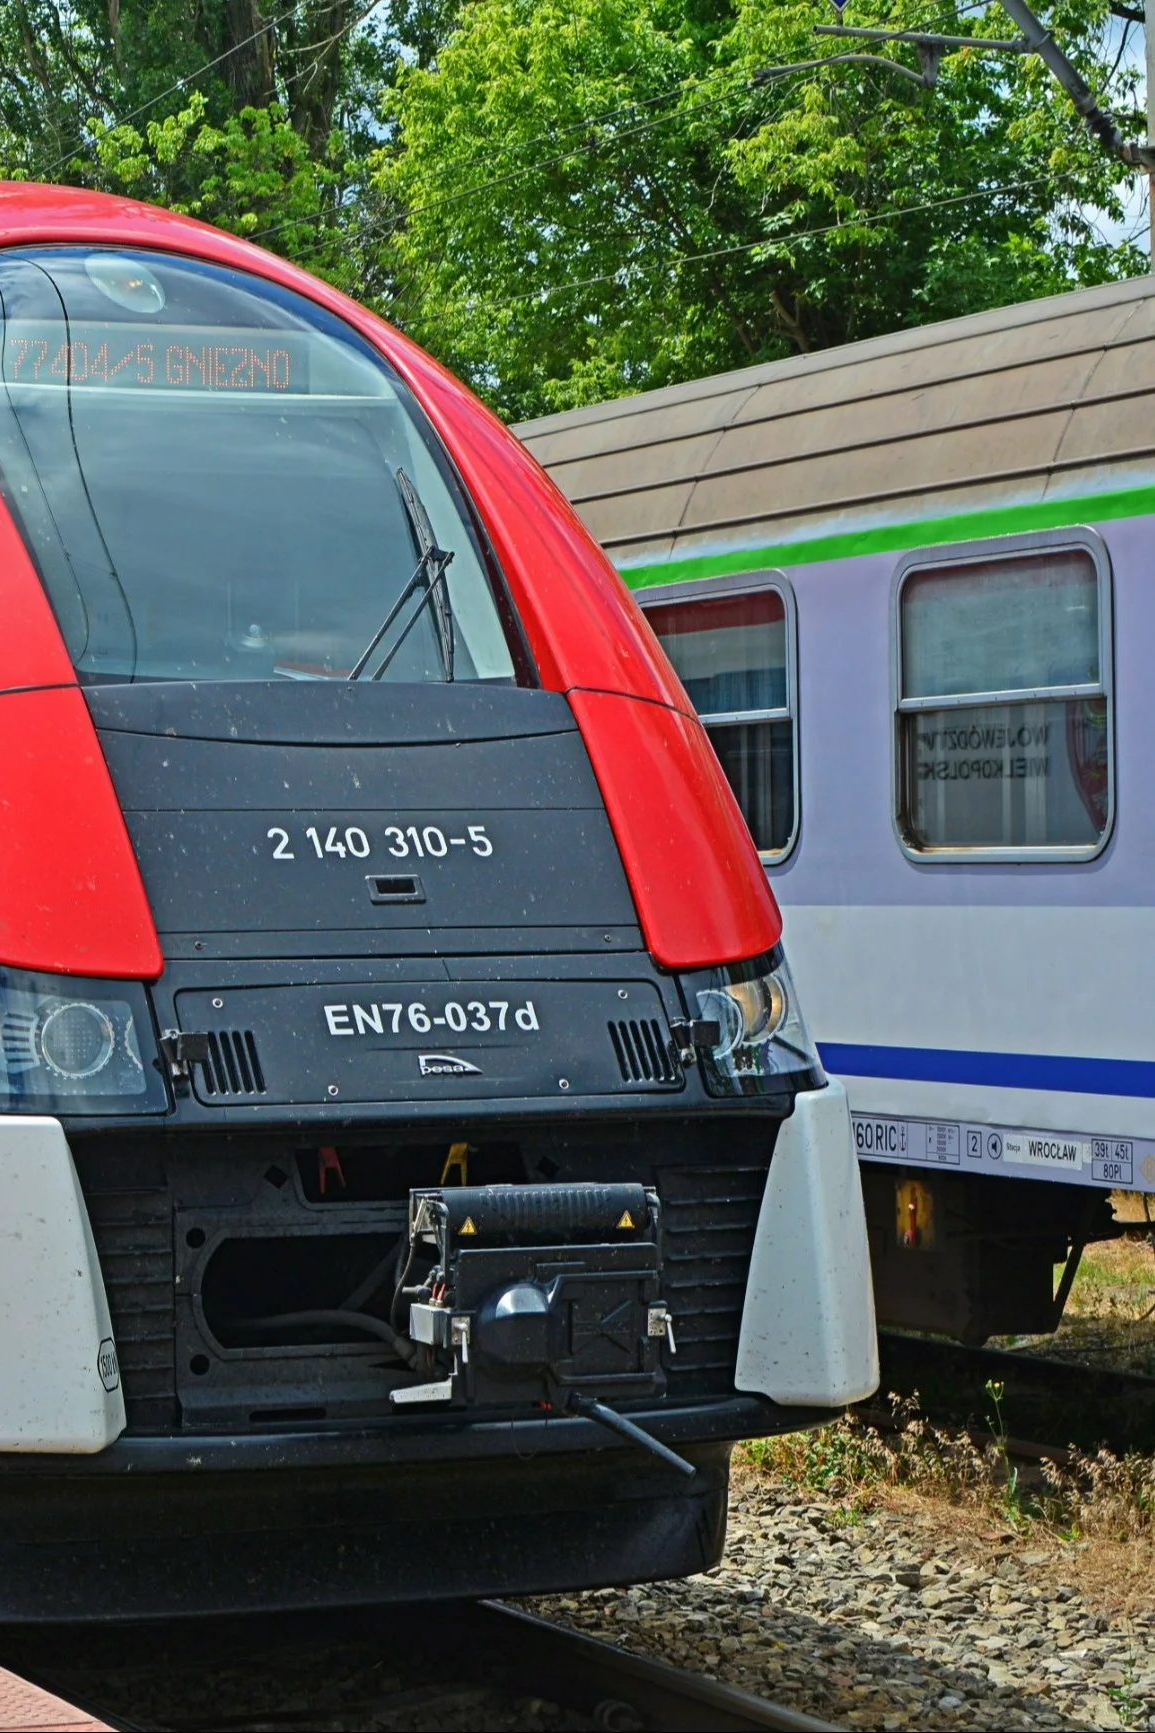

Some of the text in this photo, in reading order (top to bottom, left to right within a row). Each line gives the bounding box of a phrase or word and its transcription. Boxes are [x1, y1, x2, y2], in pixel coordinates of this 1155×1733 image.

[10, 338, 155, 385] 77404/5
[164, 344, 292, 390] GNIEZNO
[266, 825, 494, 861] 2 140 310-5
[323, 1001, 541, 1036] EN76-037d
[875, 1124, 897, 1152] RIC
[971, 1136, 978, 1153] 2
[1028, 1140, 1077, 1162] WROCŁAW
[1094, 1142, 1110, 1159] 39t
[1114, 1144, 1130, 1161] 45t
